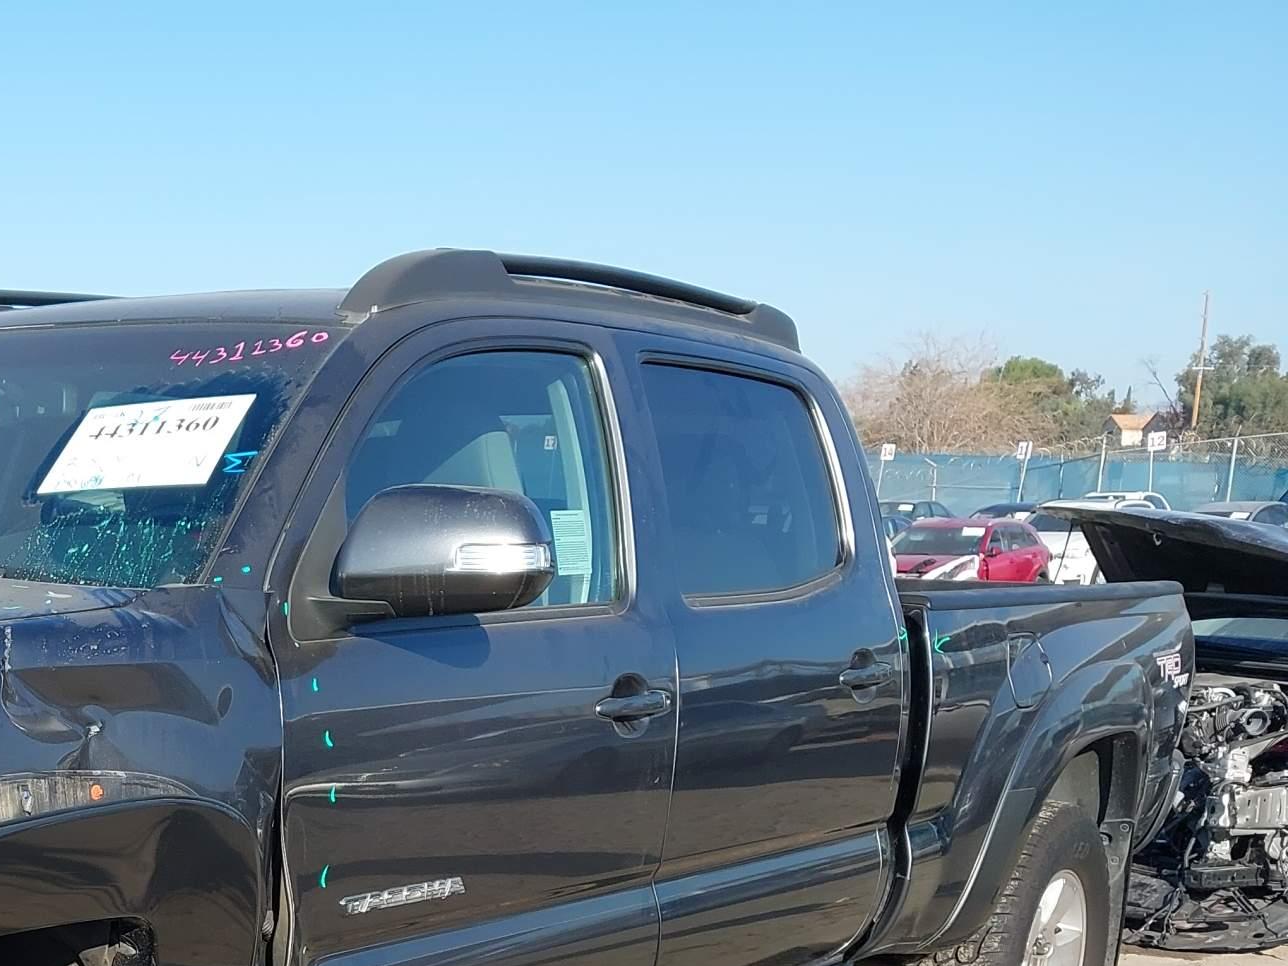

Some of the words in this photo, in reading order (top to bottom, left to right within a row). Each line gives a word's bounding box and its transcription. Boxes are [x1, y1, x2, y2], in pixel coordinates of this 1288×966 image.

[169, 330, 329, 366] 44311360
[89, 415, 220, 440] 44311360
[1156, 653, 1182, 683] TRD
